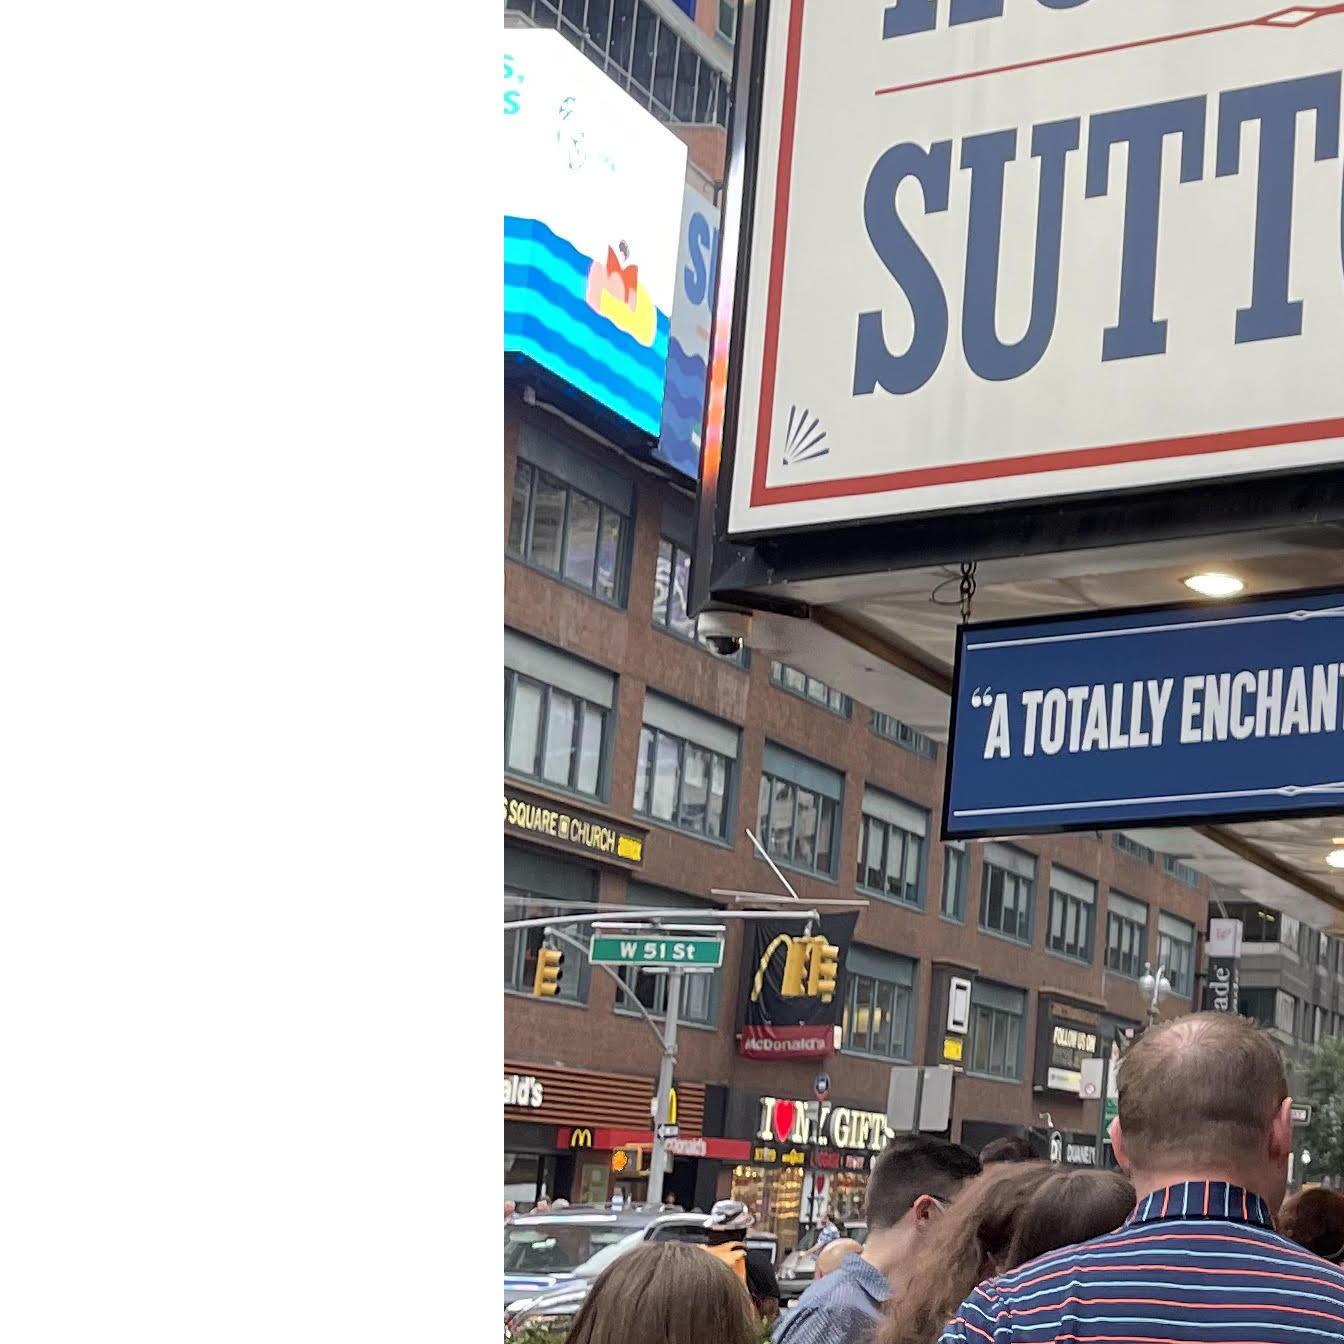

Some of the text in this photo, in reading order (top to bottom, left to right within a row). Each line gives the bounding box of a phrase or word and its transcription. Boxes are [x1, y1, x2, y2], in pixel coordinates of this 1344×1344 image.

[1021, 677, 1174, 757] TOTALLY
[508, 798, 559, 836] SQUARE
[569, 818, 616, 854] CHURCH
[620, 941, 697, 961] W 51 St
[756, 1096, 776, 1141] I
